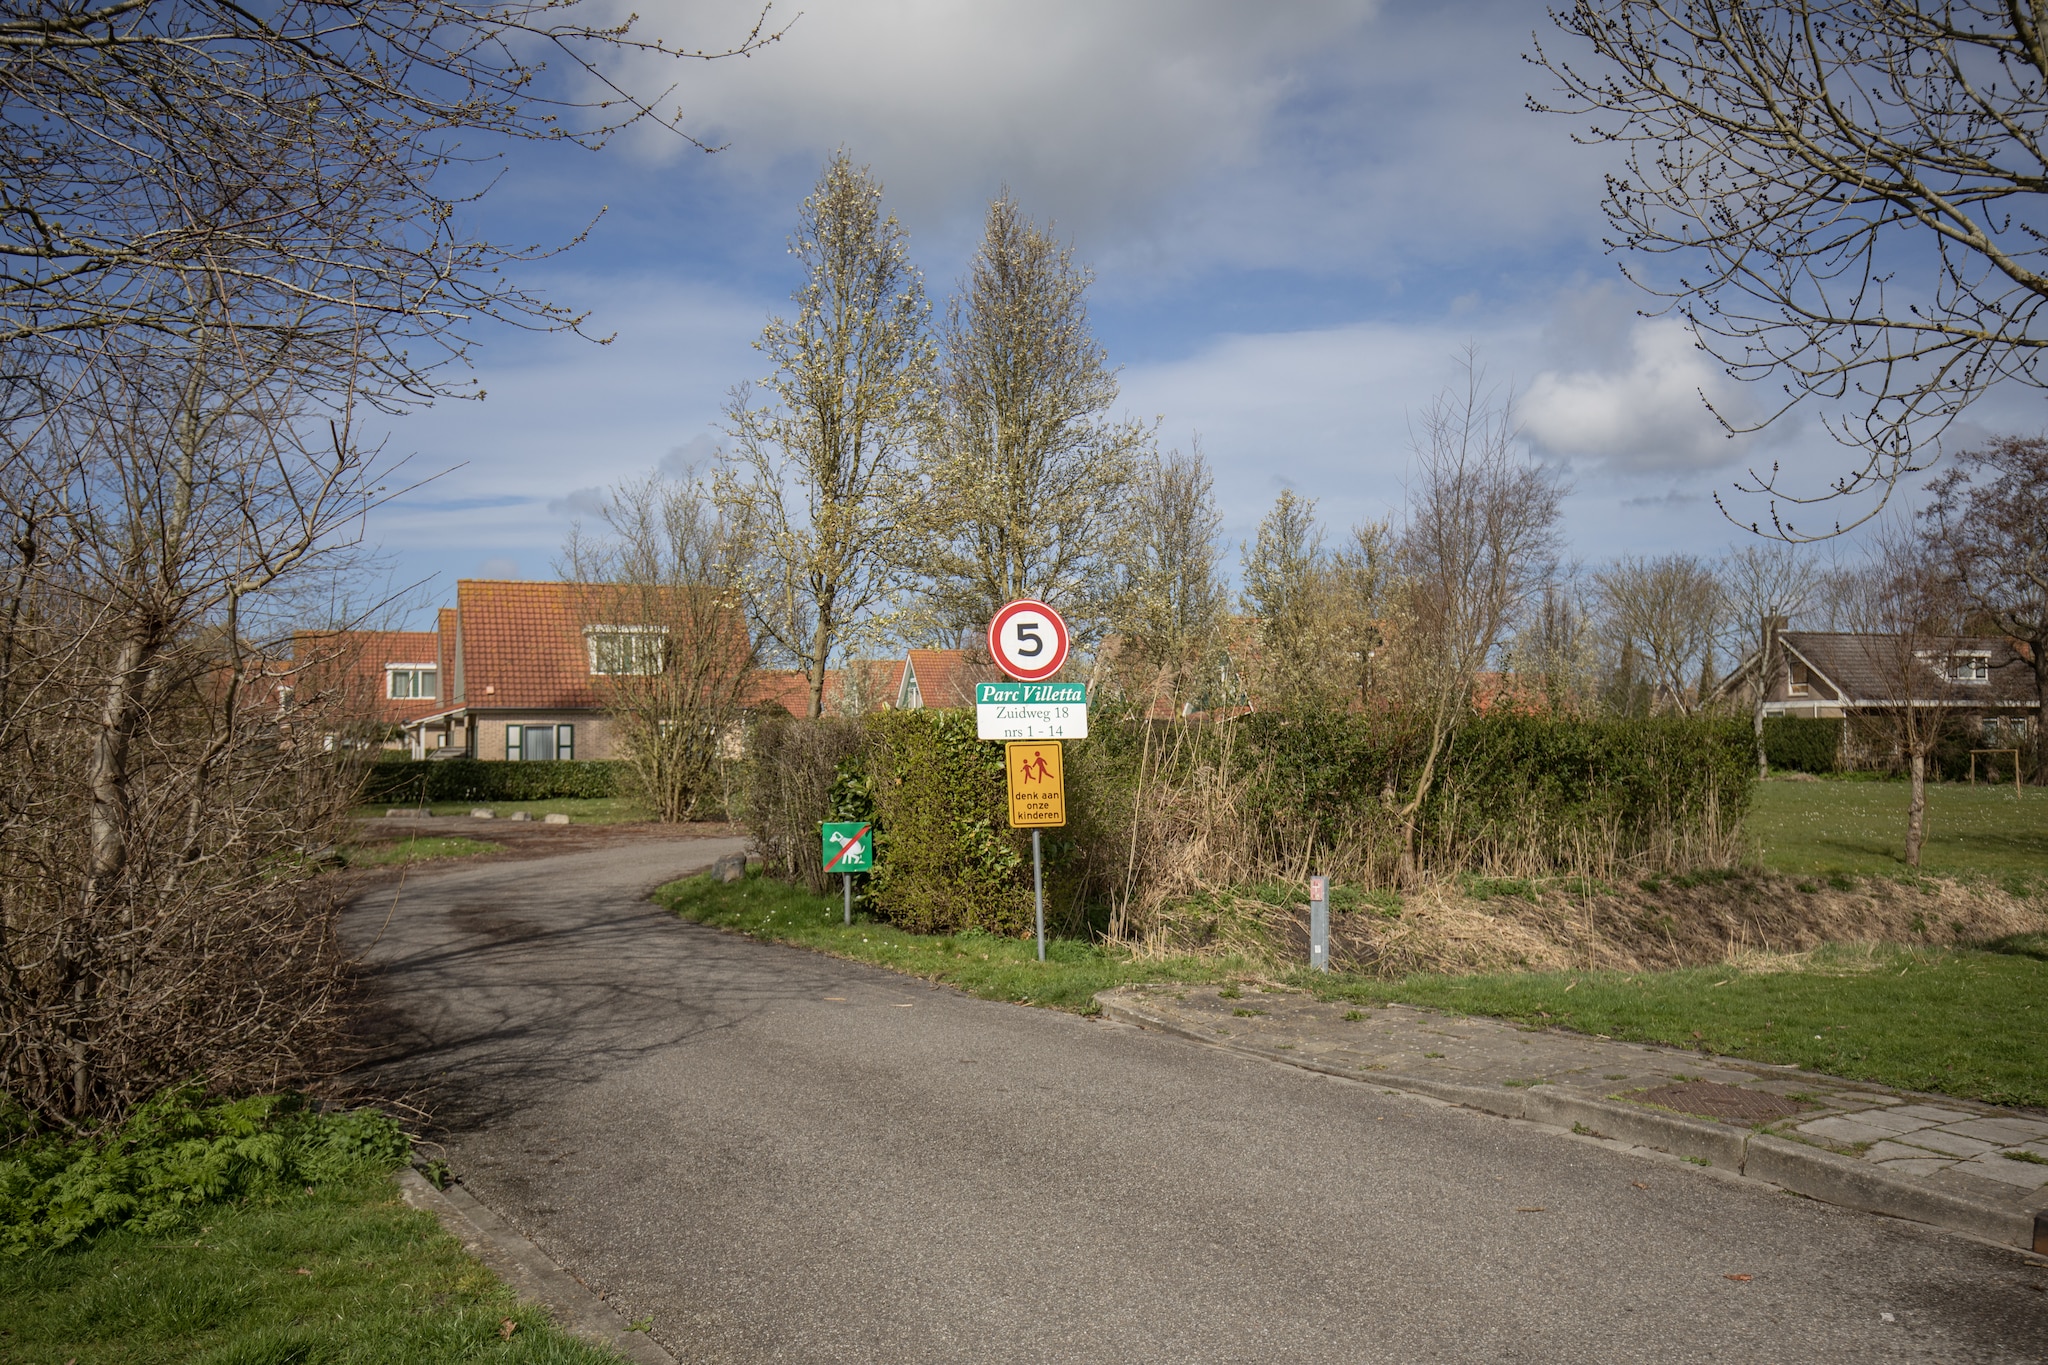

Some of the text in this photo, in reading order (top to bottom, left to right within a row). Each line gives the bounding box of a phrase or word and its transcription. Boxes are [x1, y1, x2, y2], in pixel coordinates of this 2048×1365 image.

[1016, 623, 1043, 657] 5
[982, 685, 1082, 702] Parc Villetta
[996, 706, 1069, 722] Zuidweg 18
[1004, 728, 1023, 738] nrs
[1027, 725, 1034, 737] 1
[1048, 725, 1063, 737] 14
[1015, 792, 1039, 800] denk
[1026, 802, 1049, 810] onze
[1017, 811, 1060, 820] kinderen
